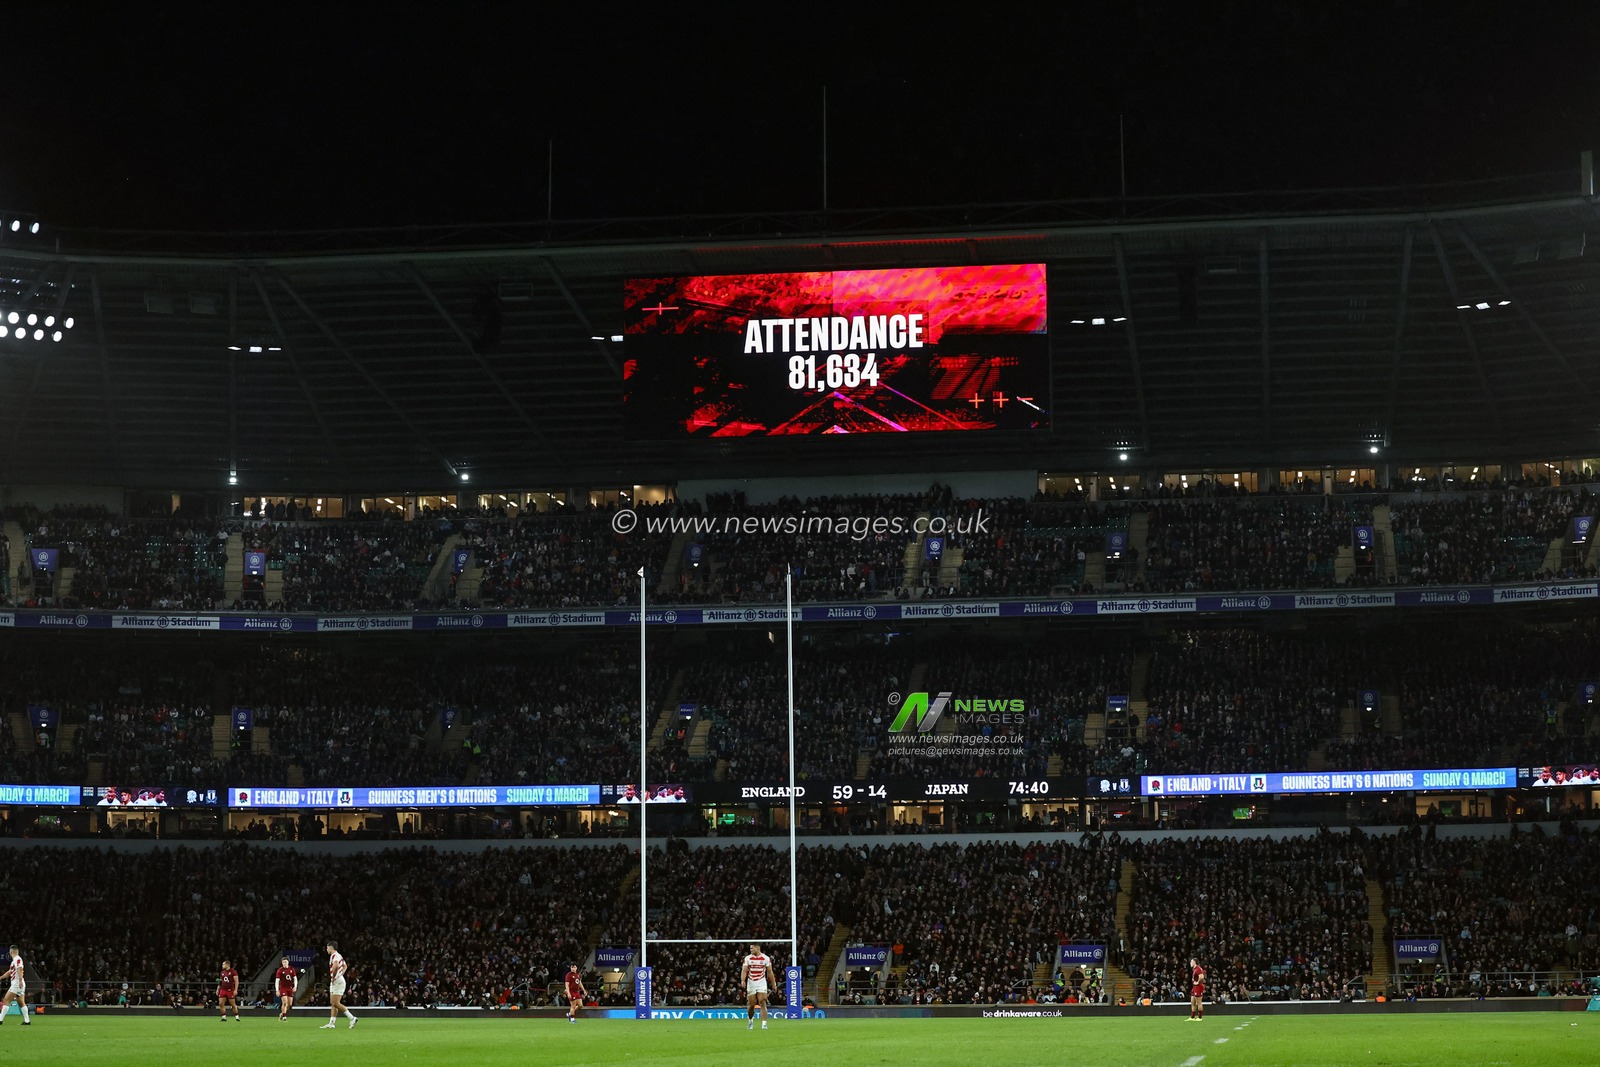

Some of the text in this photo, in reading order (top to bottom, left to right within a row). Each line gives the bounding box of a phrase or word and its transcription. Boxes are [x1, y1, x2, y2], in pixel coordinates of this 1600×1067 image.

[744, 313, 924, 354] ATTENDANCE
[788, 353, 880, 393] 81,634
[1420, 593, 1455, 603] Allianz
[1500, 587, 1592, 600] Allianz Stadium
[1101, 600, 1193, 611] Allianz Stadium
[1221, 598, 1256, 608] Allianz
[1299, 595, 1392, 606] Allianz Stadium
[827, 608, 862, 618] Allianz
[905, 605, 996, 615] Allianz Stadium
[1024, 603, 1058, 613] Allianz
[40, 615, 73, 625] Allianz
[513, 614, 601, 624] Allianz Stadium
[629, 612, 663, 622] Alanz
[708, 611, 742, 620] Allianz
[121, 616, 211, 627] Allianz Stadium
[244, 618, 278, 628] Allianz
[323, 618, 408, 628] Allianz Stadium
[437, 616, 470, 626] Allianz
[1167, 778, 1212, 792] ENGLAND
[1219, 777, 1246, 791] ITALY
[1282, 775, 1330, 790] GUINNESS
[1332, 774, 1363, 789] MEN'S
[1372, 773, 1413, 788] NATIONS
[1423, 772, 1461, 786] SUNDAY
[1463, 772, 1469, 785] 9
[1471, 771, 1506, 785] MARCH
[832, 785, 853, 799] 59
[868, 785, 887, 798] 14
[925, 783, 969, 795] JAPAN
[1009, 781, 1049, 794] 74:40
[26, 788, 33, 802] 9
[34, 788, 69, 803] MARCH
[255, 790, 299, 804] ENGLAND
[306, 790, 334, 804] ITALY
[368, 789, 415, 804] GUINNESS
[416, 789, 447, 804] MEN'S
[456, 789, 497, 803] NATIONS
[506, 788, 544, 803] SUNDAY
[546, 788, 552, 802] 9
[554, 787, 589, 802] MARCH
[1063, 949, 1092, 958] Allianz
[1399, 944, 1428, 953] Allianz
[597, 952, 625, 961] Allianz
[848, 951, 876, 960] Allianz
[638, 980, 646, 1007] Allianz
[790, 980, 798, 1007] Allianz
